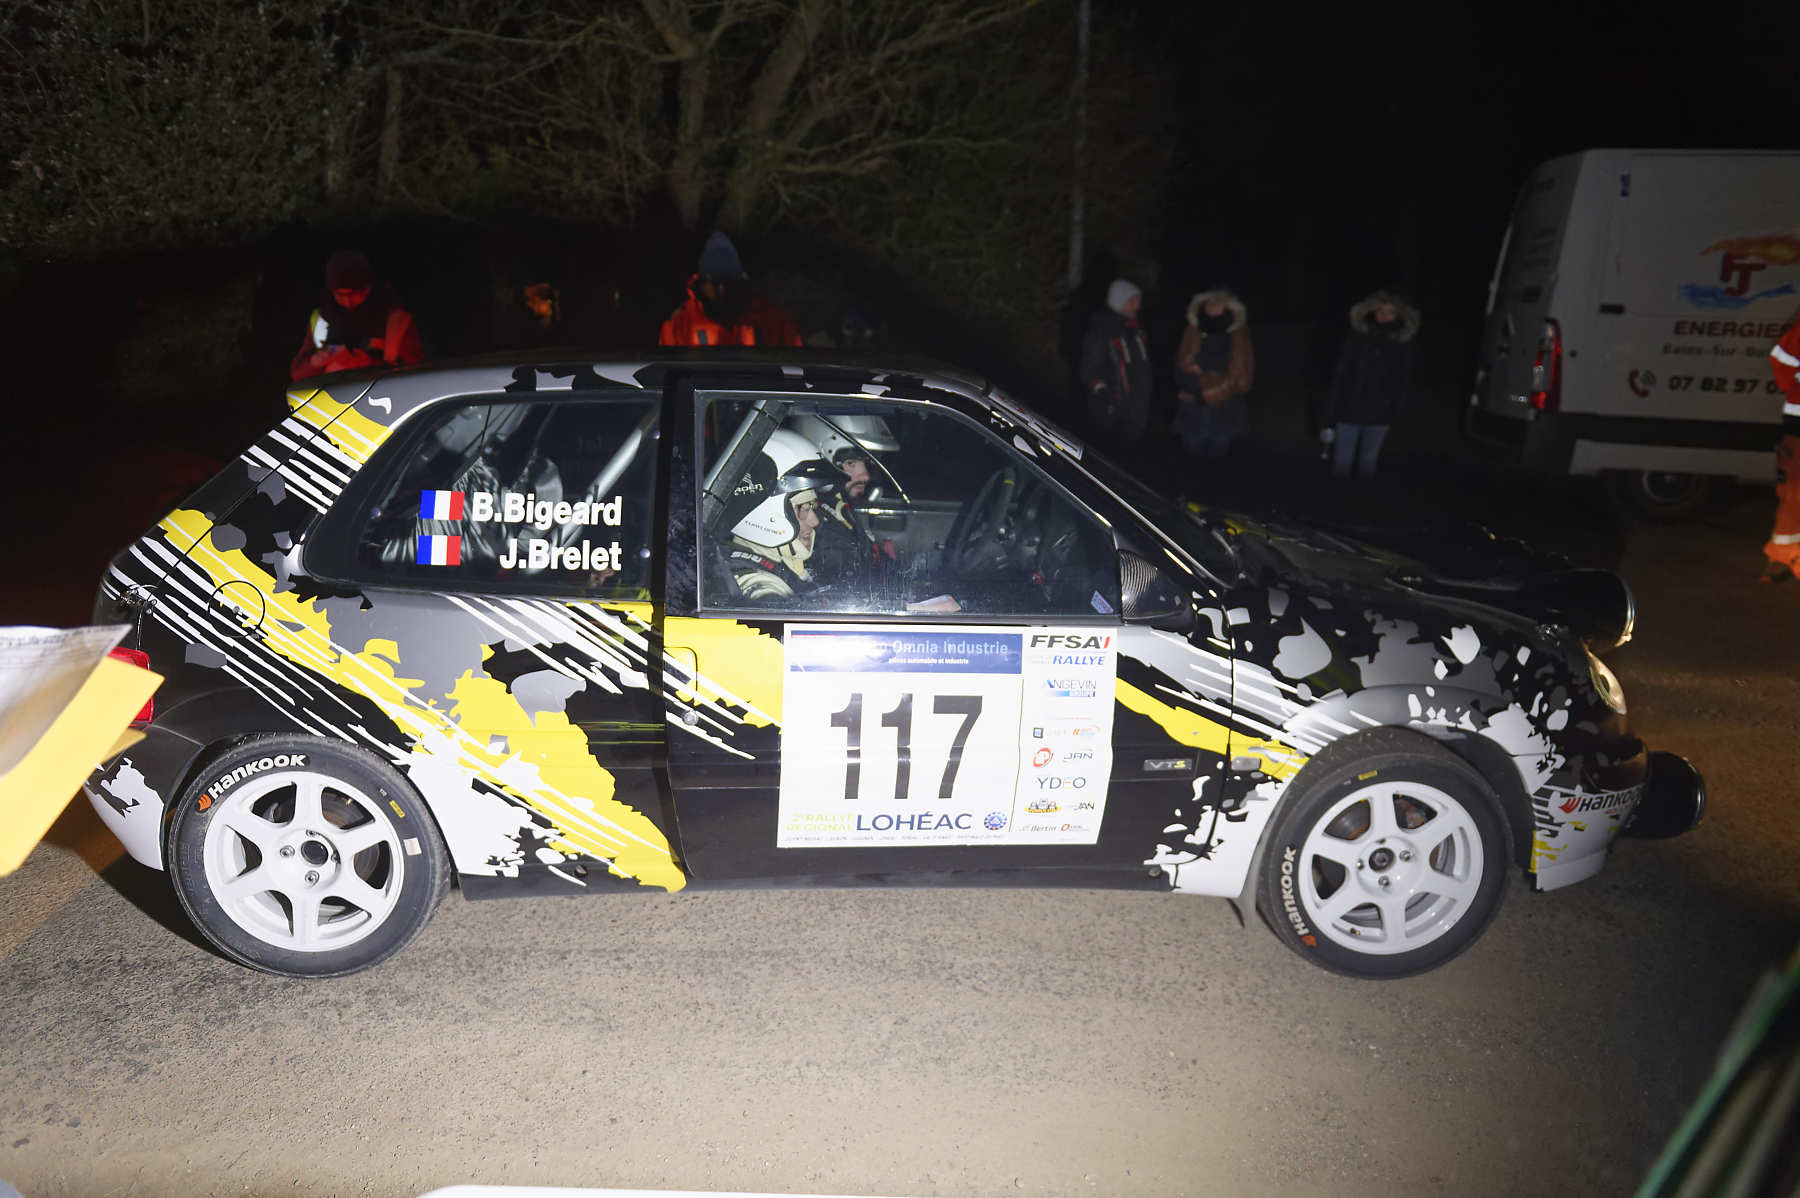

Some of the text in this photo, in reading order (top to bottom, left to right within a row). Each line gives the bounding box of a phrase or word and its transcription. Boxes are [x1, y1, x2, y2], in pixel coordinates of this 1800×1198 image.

[1668, 375, 1694, 391] 07
[1700, 376, 1727, 392] 82
[1733, 378, 1760, 393] 97
[472, 491, 622, 530] B.Bigeard
[499, 538, 622, 571] J.Brelet
[892, 639, 938, 654] Omnia
[944, 640, 1008, 655] Industrie
[1030, 634, 1101, 649] FFSA
[1052, 655, 1105, 665] RALLYE
[830, 692, 983, 800] 117
[1150, 759, 1186, 769] VTS
[856, 810, 972, 832] LOHÉAC
